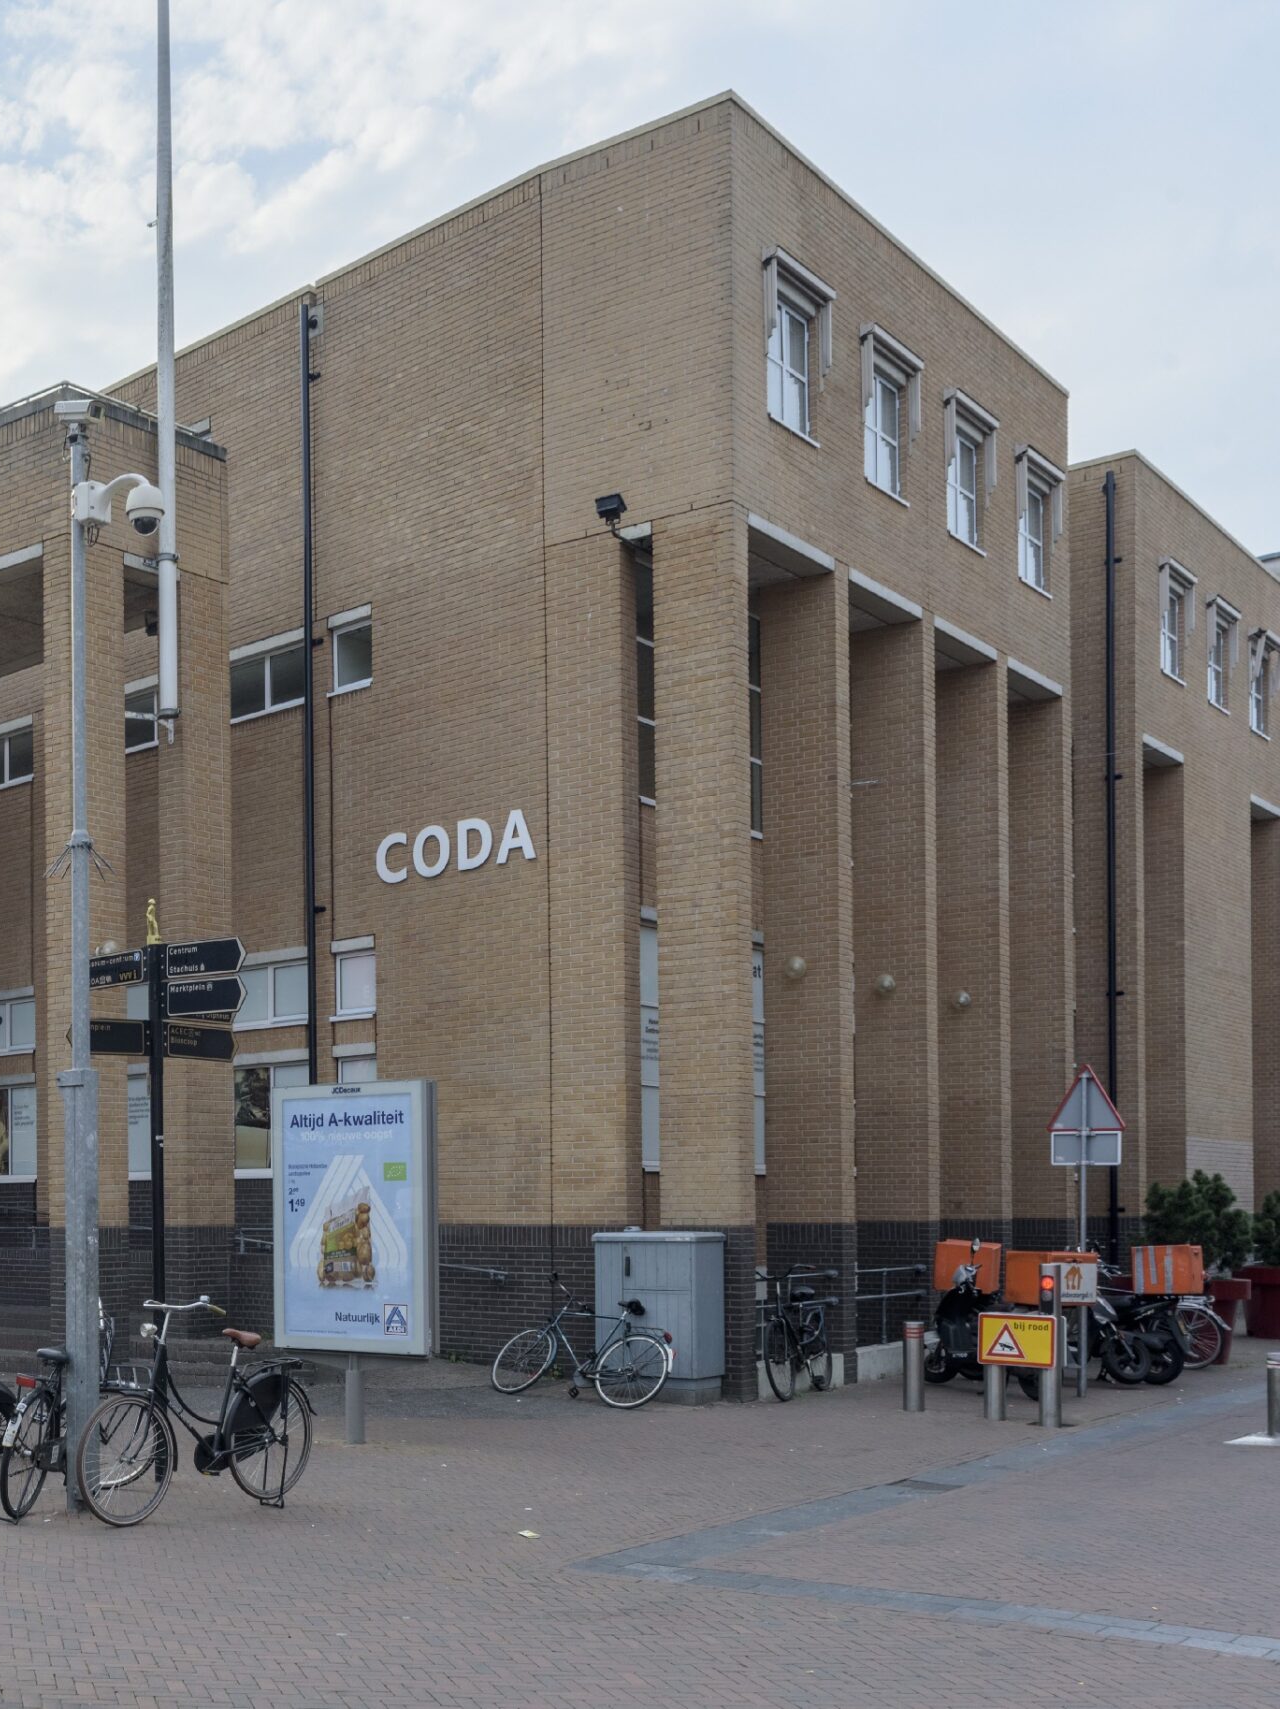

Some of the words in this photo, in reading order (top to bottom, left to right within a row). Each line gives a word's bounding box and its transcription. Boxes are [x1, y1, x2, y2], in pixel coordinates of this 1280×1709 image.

[375, 808, 538, 885] CODA
[169, 945, 198, 956] Centrum
[170, 982, 206, 994] Marktplein
[331, 1086, 361, 1095] JCDecaux
[289, 1113, 325, 1131] Altijd
[328, 1109, 405, 1128] A-kwaliteit
[301, 1130, 324, 1142] 100%
[363, 1129, 393, 1140] oogst
[288, 1198, 305, 1213] 1.49
[334, 1311, 381, 1326] Natuurlijk
[387, 1326, 406, 1334] ALDI
[1013, 1322, 1025, 1332] bij
[1028, 1323, 1049, 1331] rood
